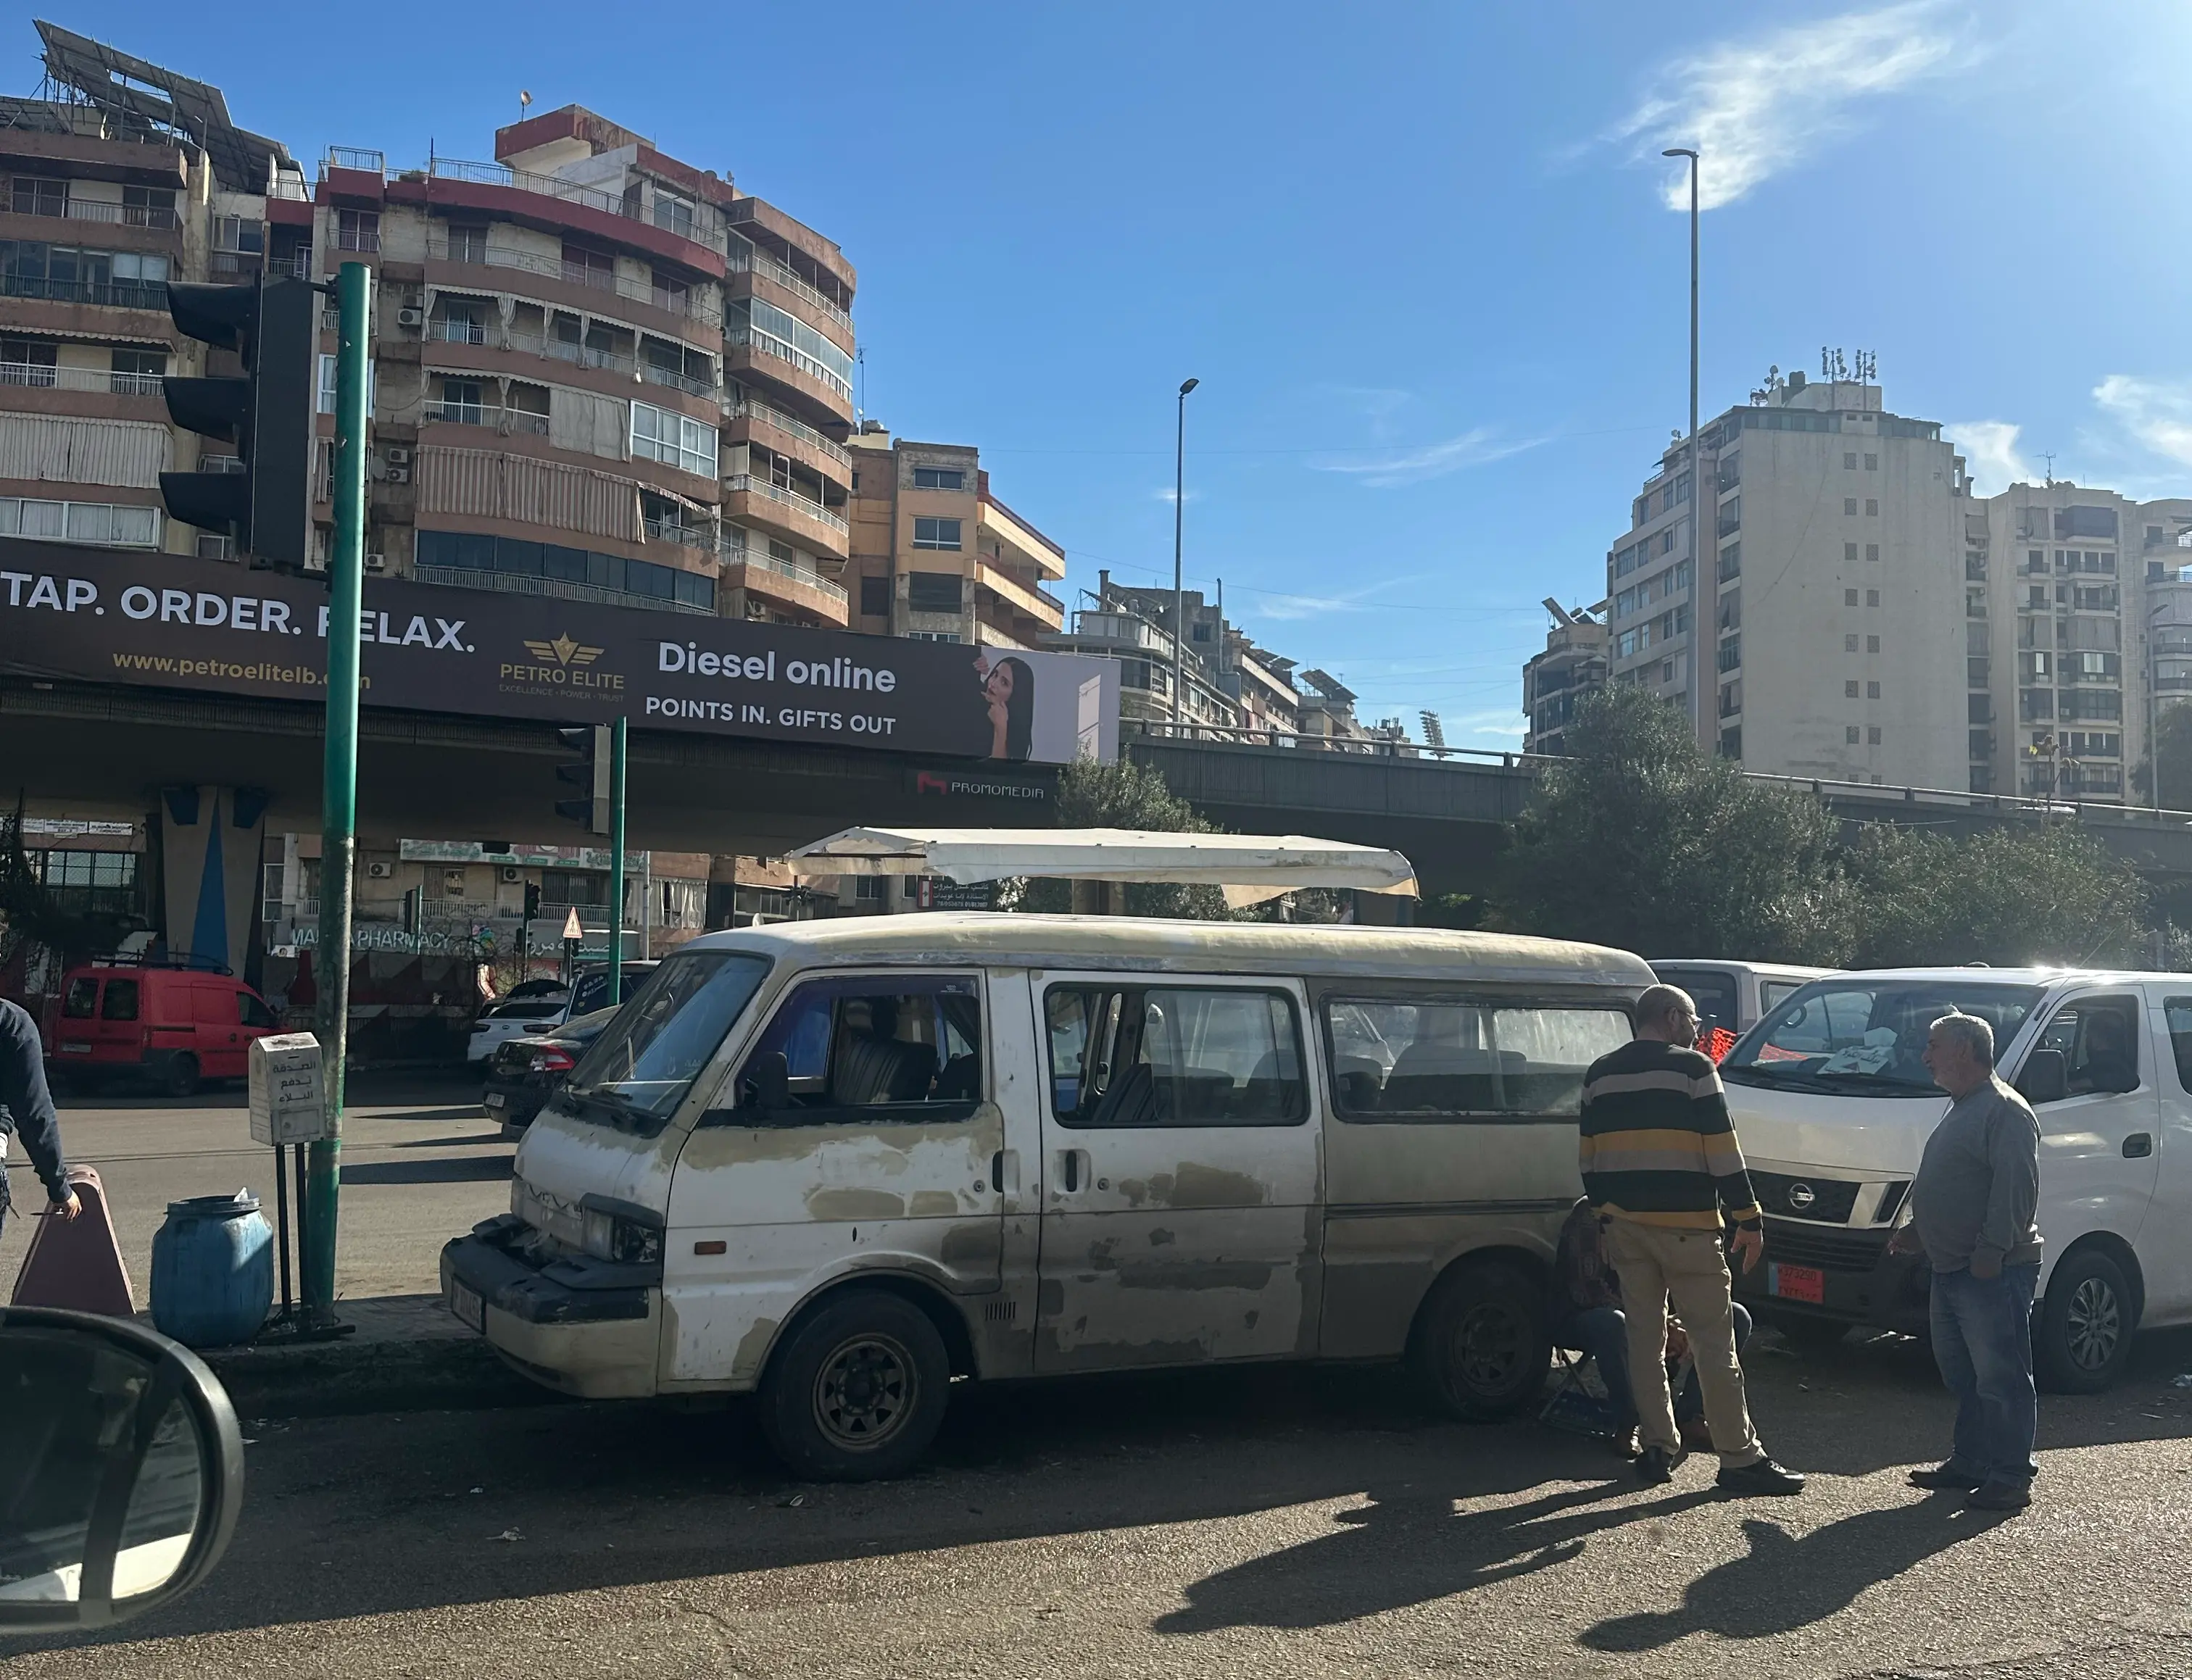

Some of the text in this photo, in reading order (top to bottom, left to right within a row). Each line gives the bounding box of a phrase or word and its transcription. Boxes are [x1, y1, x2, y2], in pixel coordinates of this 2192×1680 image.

[1, 571, 104, 615] TAP.
[121, 586, 302, 636] ORDER.
[113, 653, 370, 689] www.petroelitelb.m
[500, 663, 624, 689] PETRO ELITE
[659, 641, 896, 692] Diesel online
[499, 684, 624, 703] EXCELLENCE POWER TRUST
[646, 696, 897, 734] POINTS IN. GIFTS OUT
[951, 781, 1045, 799] PROMOMEDIA
[934, 882, 953, 891] بيروت
[357, 929, 452, 949] PHARMACY
[273, 1061, 316, 1073] الصدقة
[281, 1076, 312, 1089] تدفع
[279, 1091, 313, 1102] البلاء
